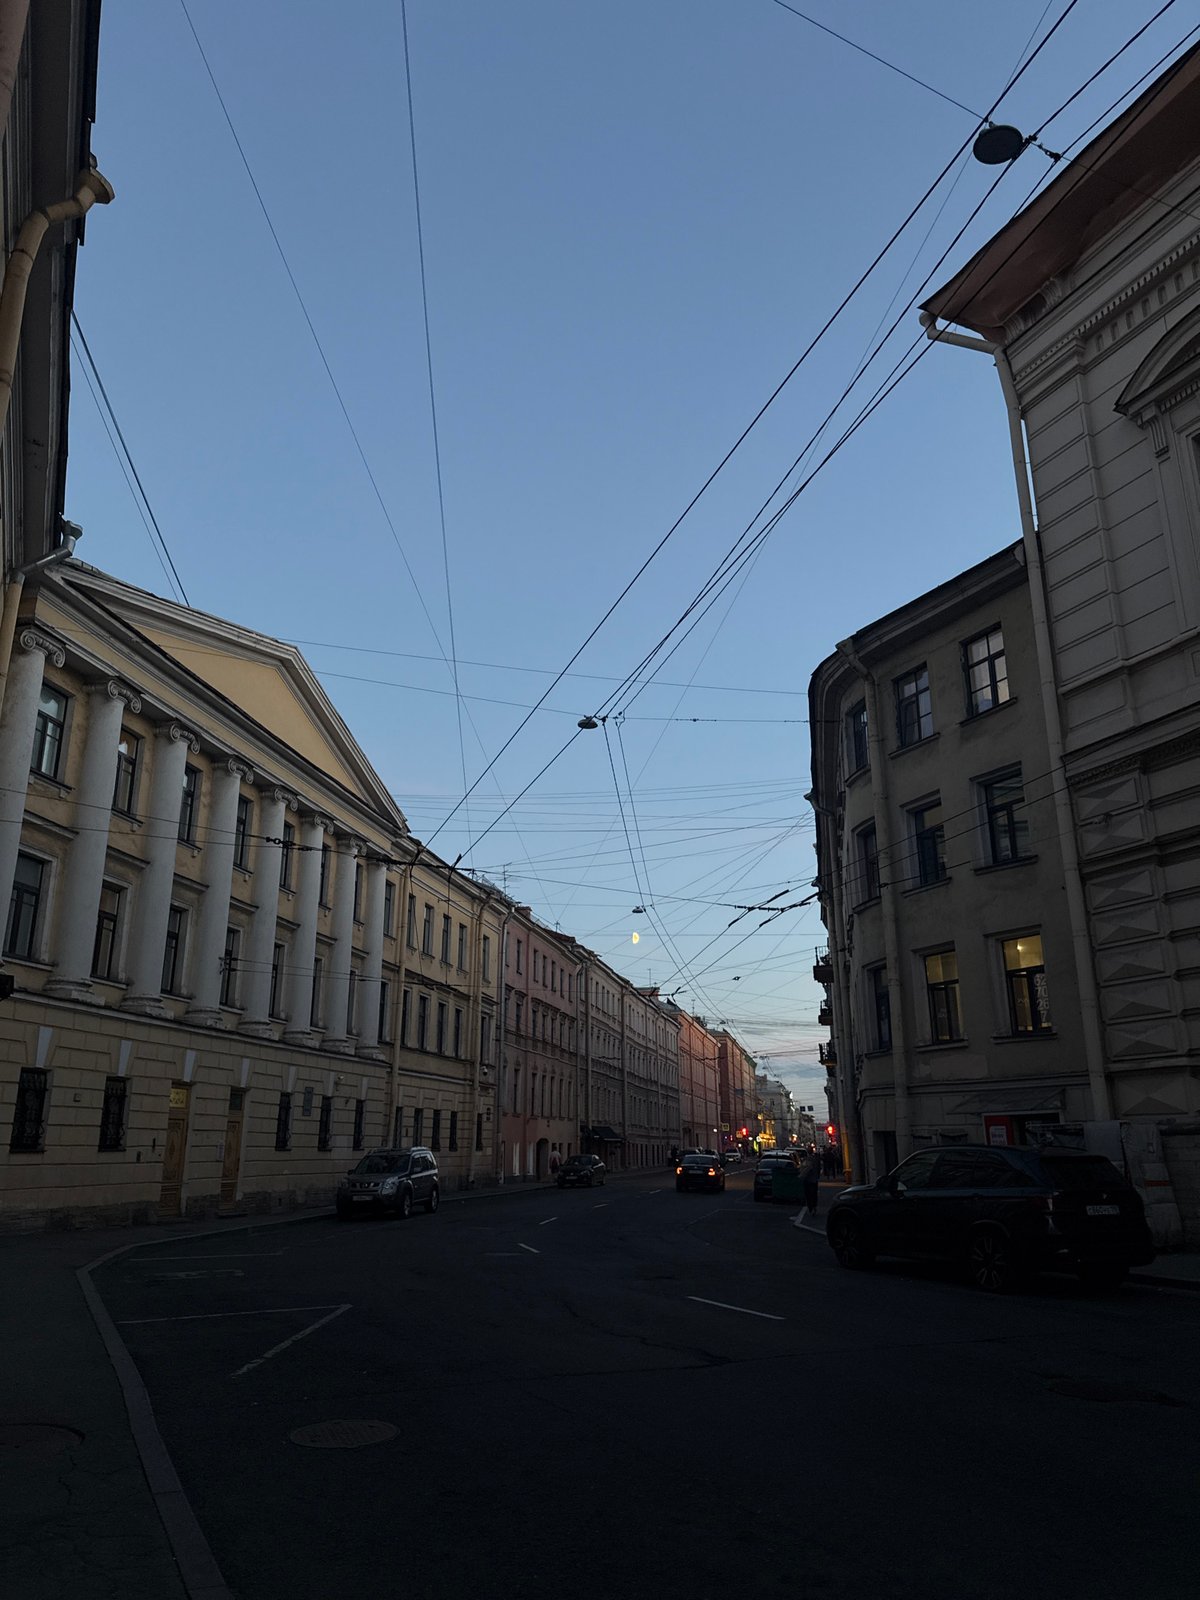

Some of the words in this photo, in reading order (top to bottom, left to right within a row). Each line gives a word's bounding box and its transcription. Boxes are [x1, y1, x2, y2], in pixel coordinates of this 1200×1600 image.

[1035, 986, 1048, 997] 70
[1037, 998, 1049, 1010] 26
[1040, 1010, 1047, 1022] 7
